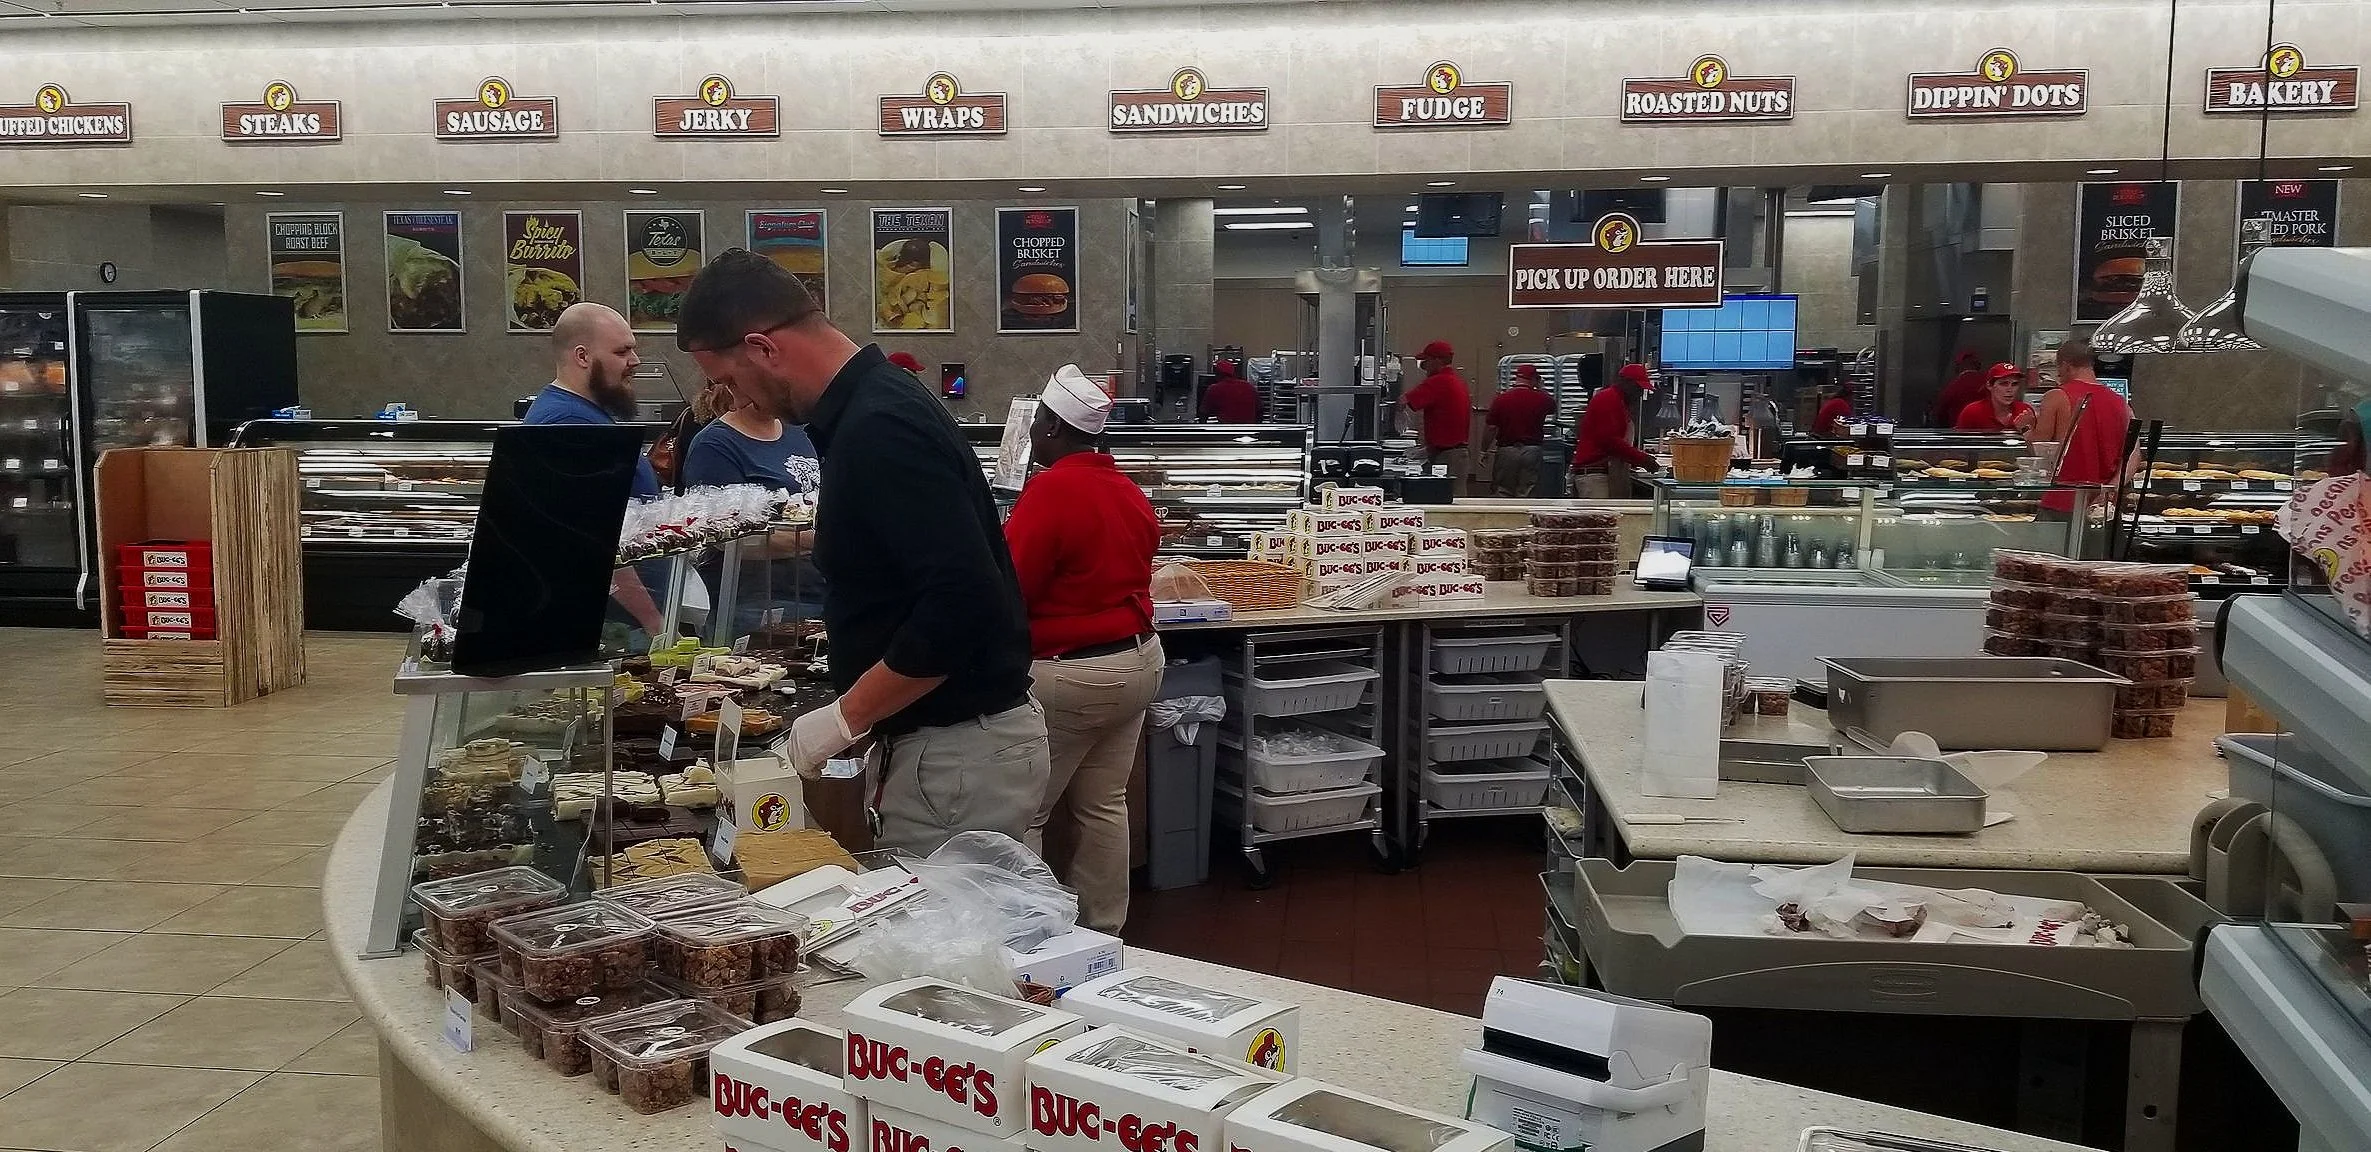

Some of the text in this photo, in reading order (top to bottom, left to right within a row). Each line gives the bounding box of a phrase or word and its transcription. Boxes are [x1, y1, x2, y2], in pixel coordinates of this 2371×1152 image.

[1626, 91, 1788, 114] ROASTED NUTS
[1914, 84, 2080, 109] DIPPIN' DOTS
[2229, 81, 2338, 105] BAKERY
[901, 107, 984, 129] WRAPS
[1113, 103, 1264, 125] SANDWICHES
[1401, 97, 1485, 120] FUDGE
[48, 116, 123, 135] CHICKENS
[240, 114, 320, 134] STEAKS
[447, 111, 544, 132] SAUSAGE
[680, 109, 752, 130] JERKY
[2275, 185, 2302, 194] NEW
[275, 223, 337, 236] CHOPPING BLOCK
[879, 213, 945, 227] THE TEXAN
[2106, 215, 2151, 228] SLICED
[2292, 222, 2327, 235] PORK
[522, 216, 565, 245] Spicy
[647, 231, 681, 246] Texas
[2101, 227, 2156, 241] BRISKET
[285, 236, 329, 249] ROAST BEEF
[509, 239, 577, 260] Burrito
[1013, 237, 1066, 248] CHOPPED
[1017, 248, 1062, 259] BRISKET
[1516, 266, 1716, 290] PICK UP ORDER HERE
[847, 1028, 999, 1118] BUC-EE'S
